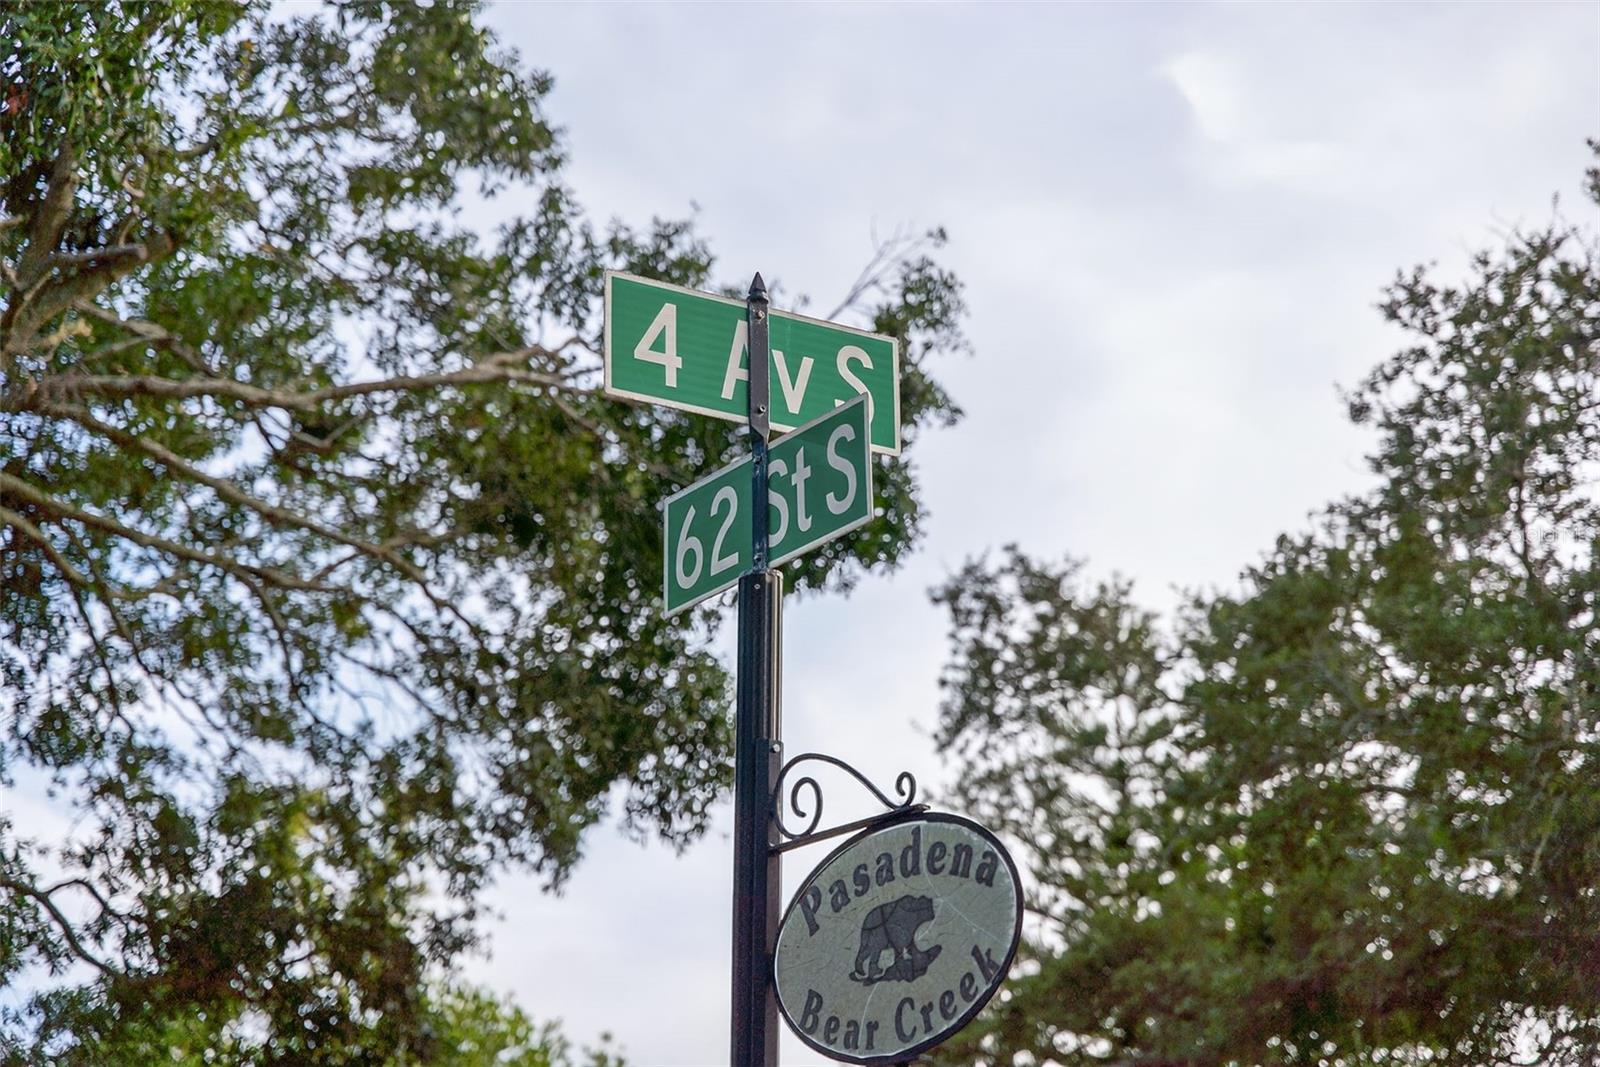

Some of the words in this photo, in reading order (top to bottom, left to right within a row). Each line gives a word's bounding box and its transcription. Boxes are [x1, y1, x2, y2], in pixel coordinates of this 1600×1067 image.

[634, 302, 683, 388] 4
[721, 319, 815, 415] Av
[834, 345, 875, 425] S
[675, 485, 740, 590] 62
[767, 445, 813, 548] St
[825, 423, 858, 515] S
[799, 825, 1000, 937] Pasadena
[800, 988, 879, 1050] Bear
[894, 943, 1002, 1044] Creek
